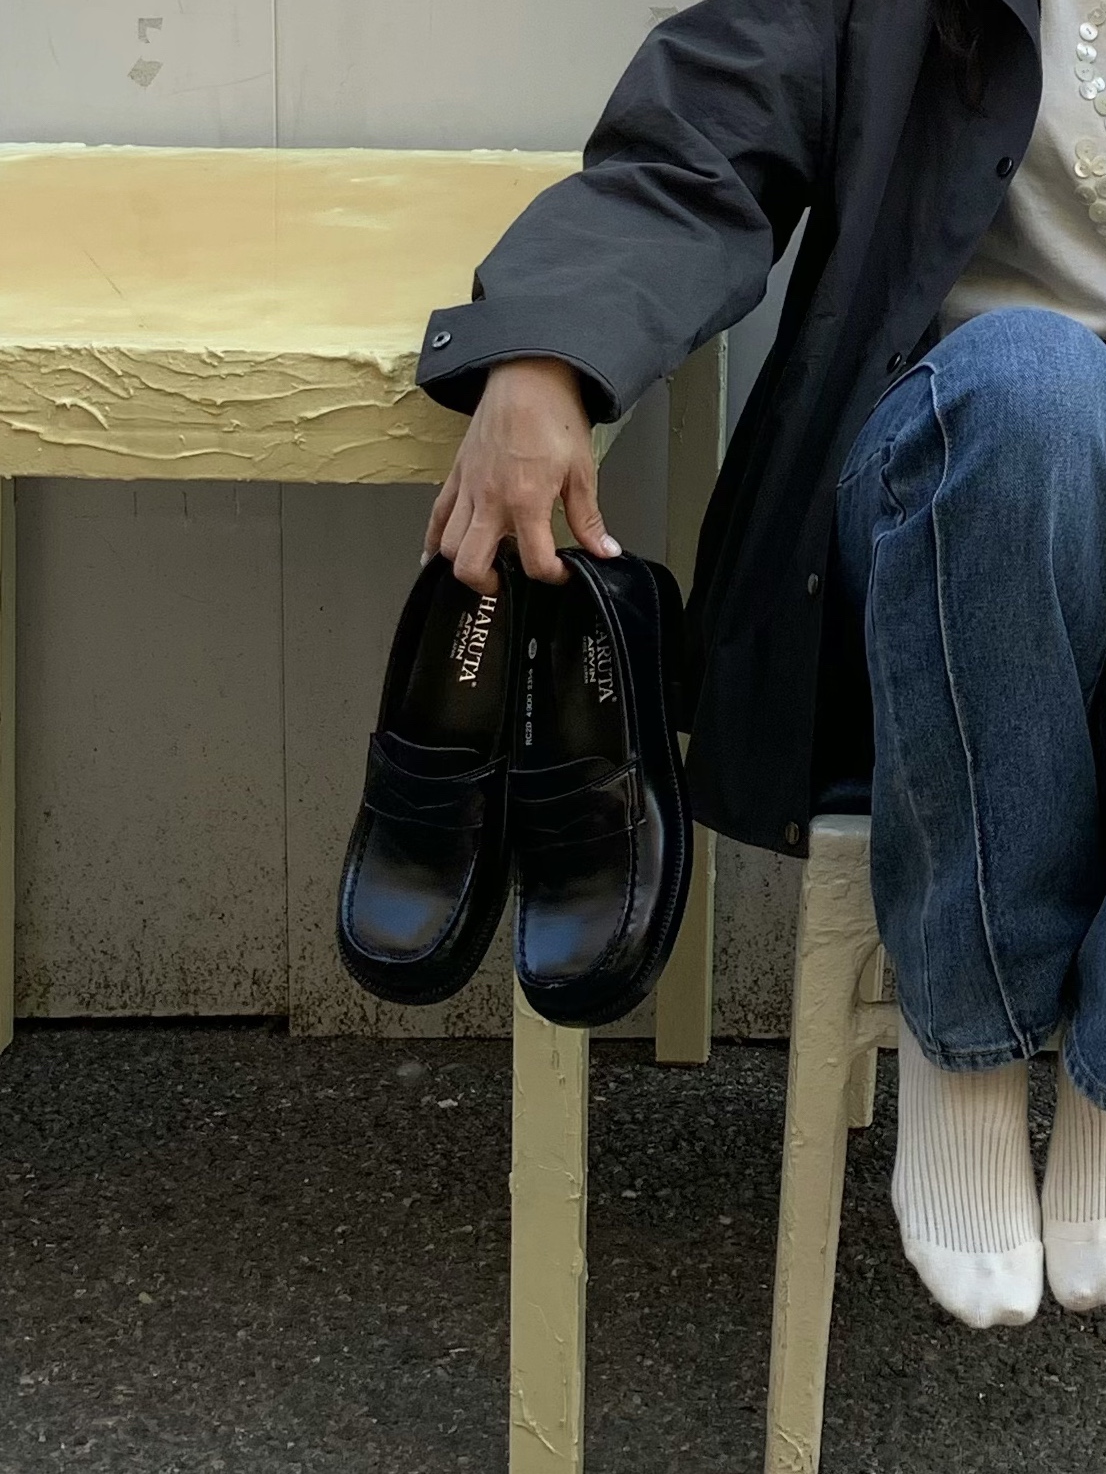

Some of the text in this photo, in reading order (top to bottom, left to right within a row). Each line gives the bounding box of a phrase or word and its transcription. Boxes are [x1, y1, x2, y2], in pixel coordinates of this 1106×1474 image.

[455, 612, 473, 661] ARVIN
[458, 595, 498, 682] HARUTA
[587, 635, 597, 683] ARVIN
[596, 614, 614, 703] ARUTA
